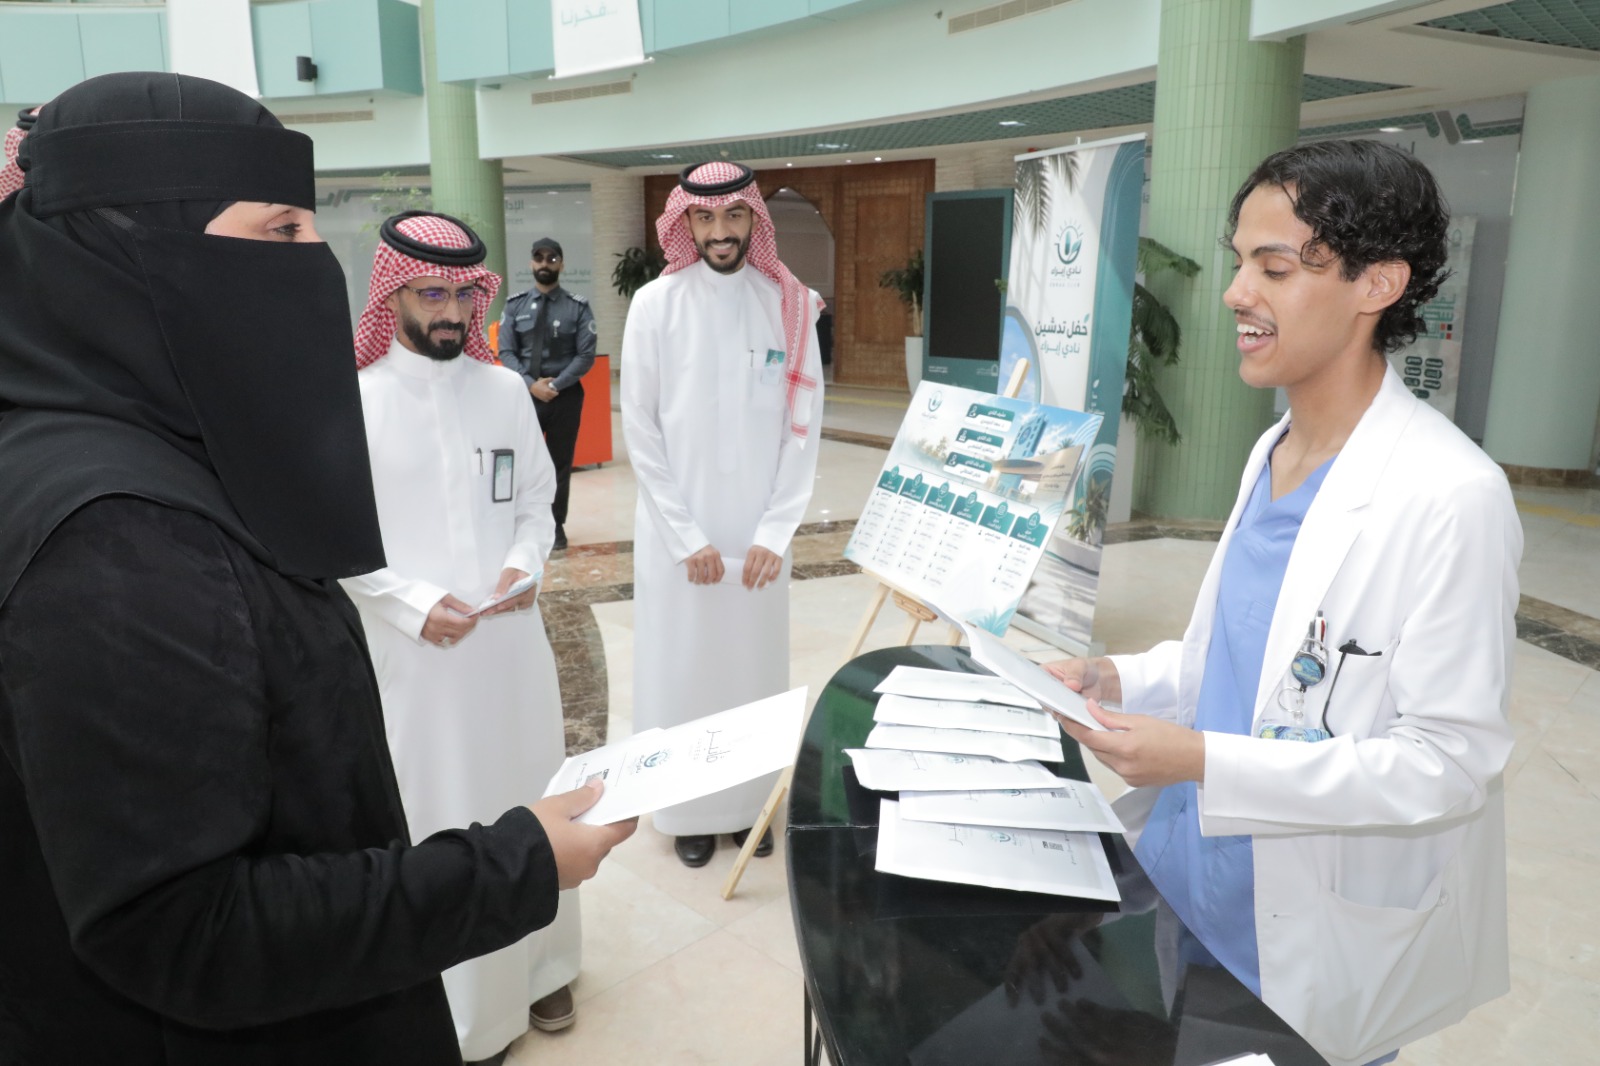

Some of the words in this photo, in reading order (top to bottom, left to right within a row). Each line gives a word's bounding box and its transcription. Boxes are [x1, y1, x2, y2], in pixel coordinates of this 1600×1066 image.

[1066, 266, 1082, 279] نادي
[1034, 317, 1067, 337] تدشين
[1066, 320, 1088, 339] حفل
[1062, 342, 1081, 358] نادي
